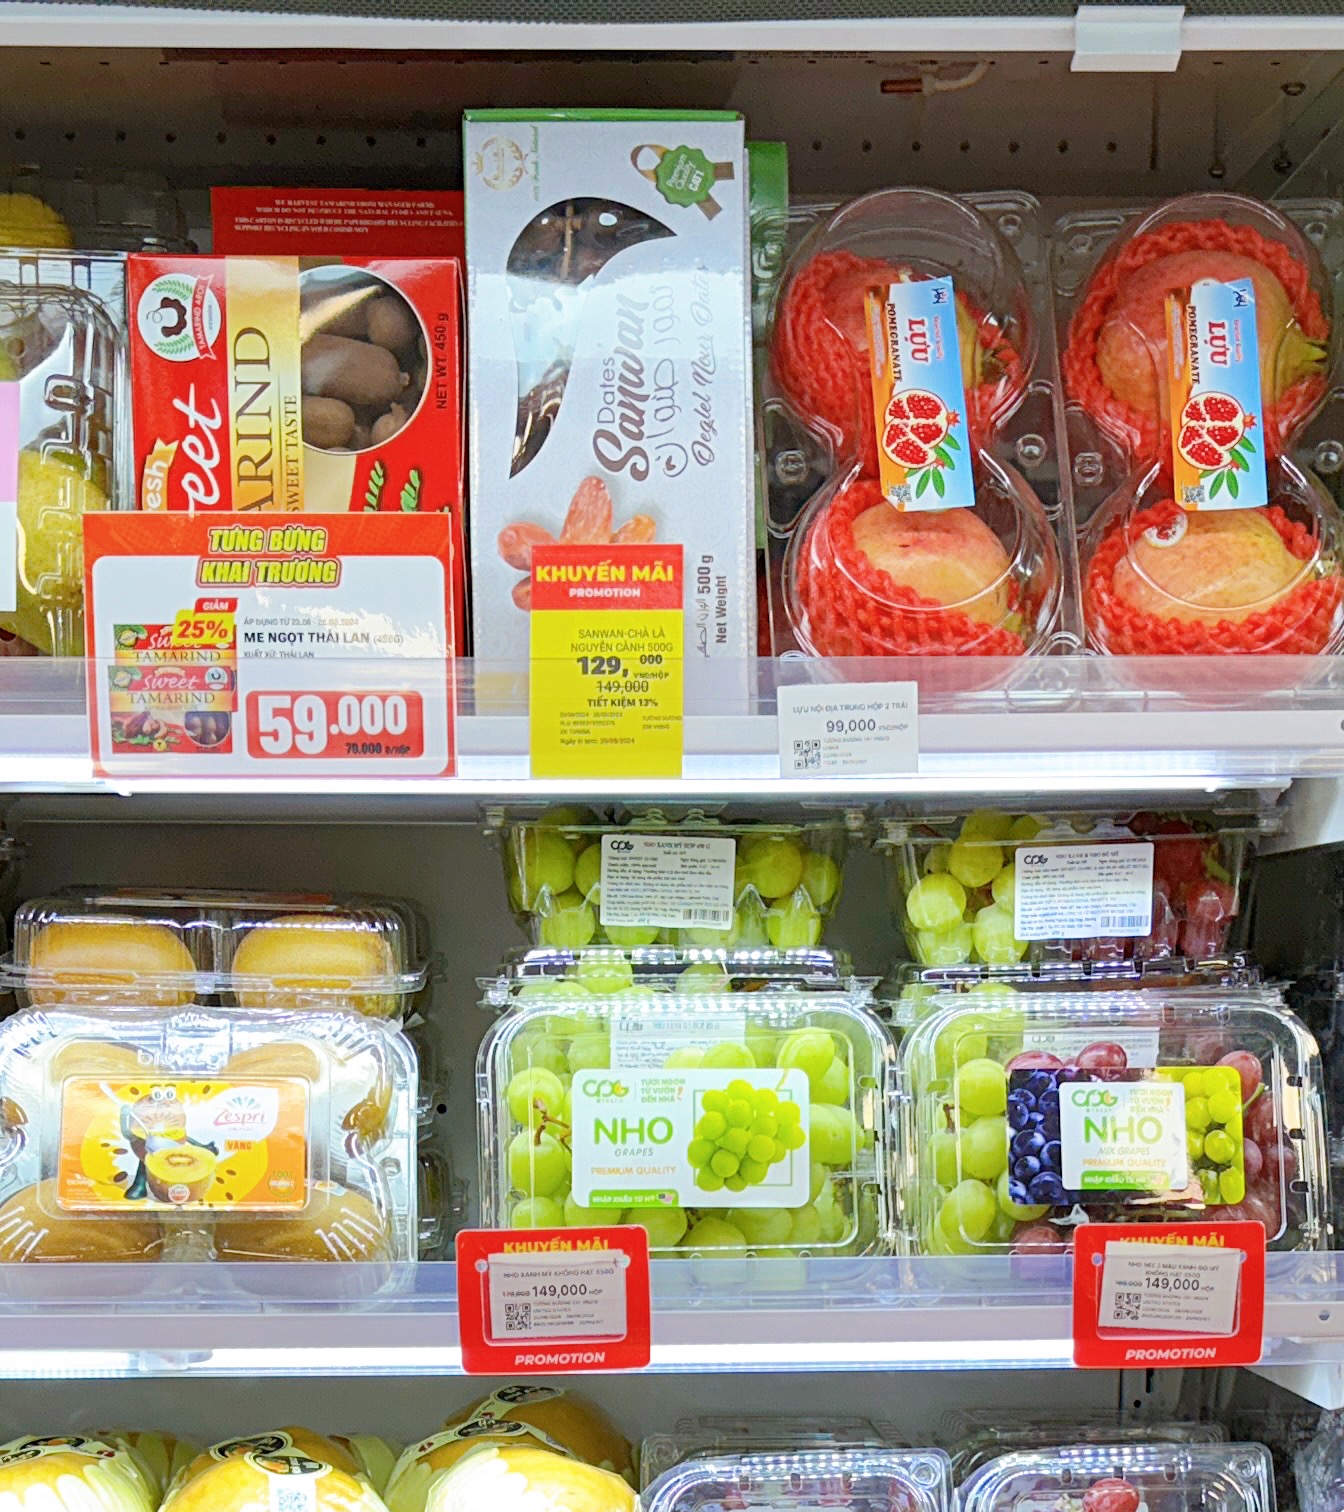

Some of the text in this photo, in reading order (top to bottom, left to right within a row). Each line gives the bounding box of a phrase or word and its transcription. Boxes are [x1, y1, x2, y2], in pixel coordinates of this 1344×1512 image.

[437, 324, 447, 352] 450
[886, 302, 902, 383] POMEGRANATE
[436, 387, 447, 410] NET
[592, 292, 651, 482] Sanwan
[597, 357, 616, 424] Dates
[283, 394, 298, 451] TASTE
[535, 560, 674, 583] KHUYẾN MÃI
[568, 587, 641, 598] PROMOTION
[715, 575, 728, 644] Net Weight
[177, 619, 229, 641] 25%
[244, 629, 370, 648] ME NGỌT THÁI LAN
[258, 694, 408, 756] 59.000
[825, 719, 877, 735] 99,000
[593, 1116, 674, 1146] NHO
[614, 1147, 654, 1158] GRAPES
[531, 1283, 588, 1299] 149,000
[1144, 1277, 1200, 1294] 149,000
[514, 1351, 606, 1367] PROMOTION
[1124, 1347, 1217, 1362] PROMOTION
